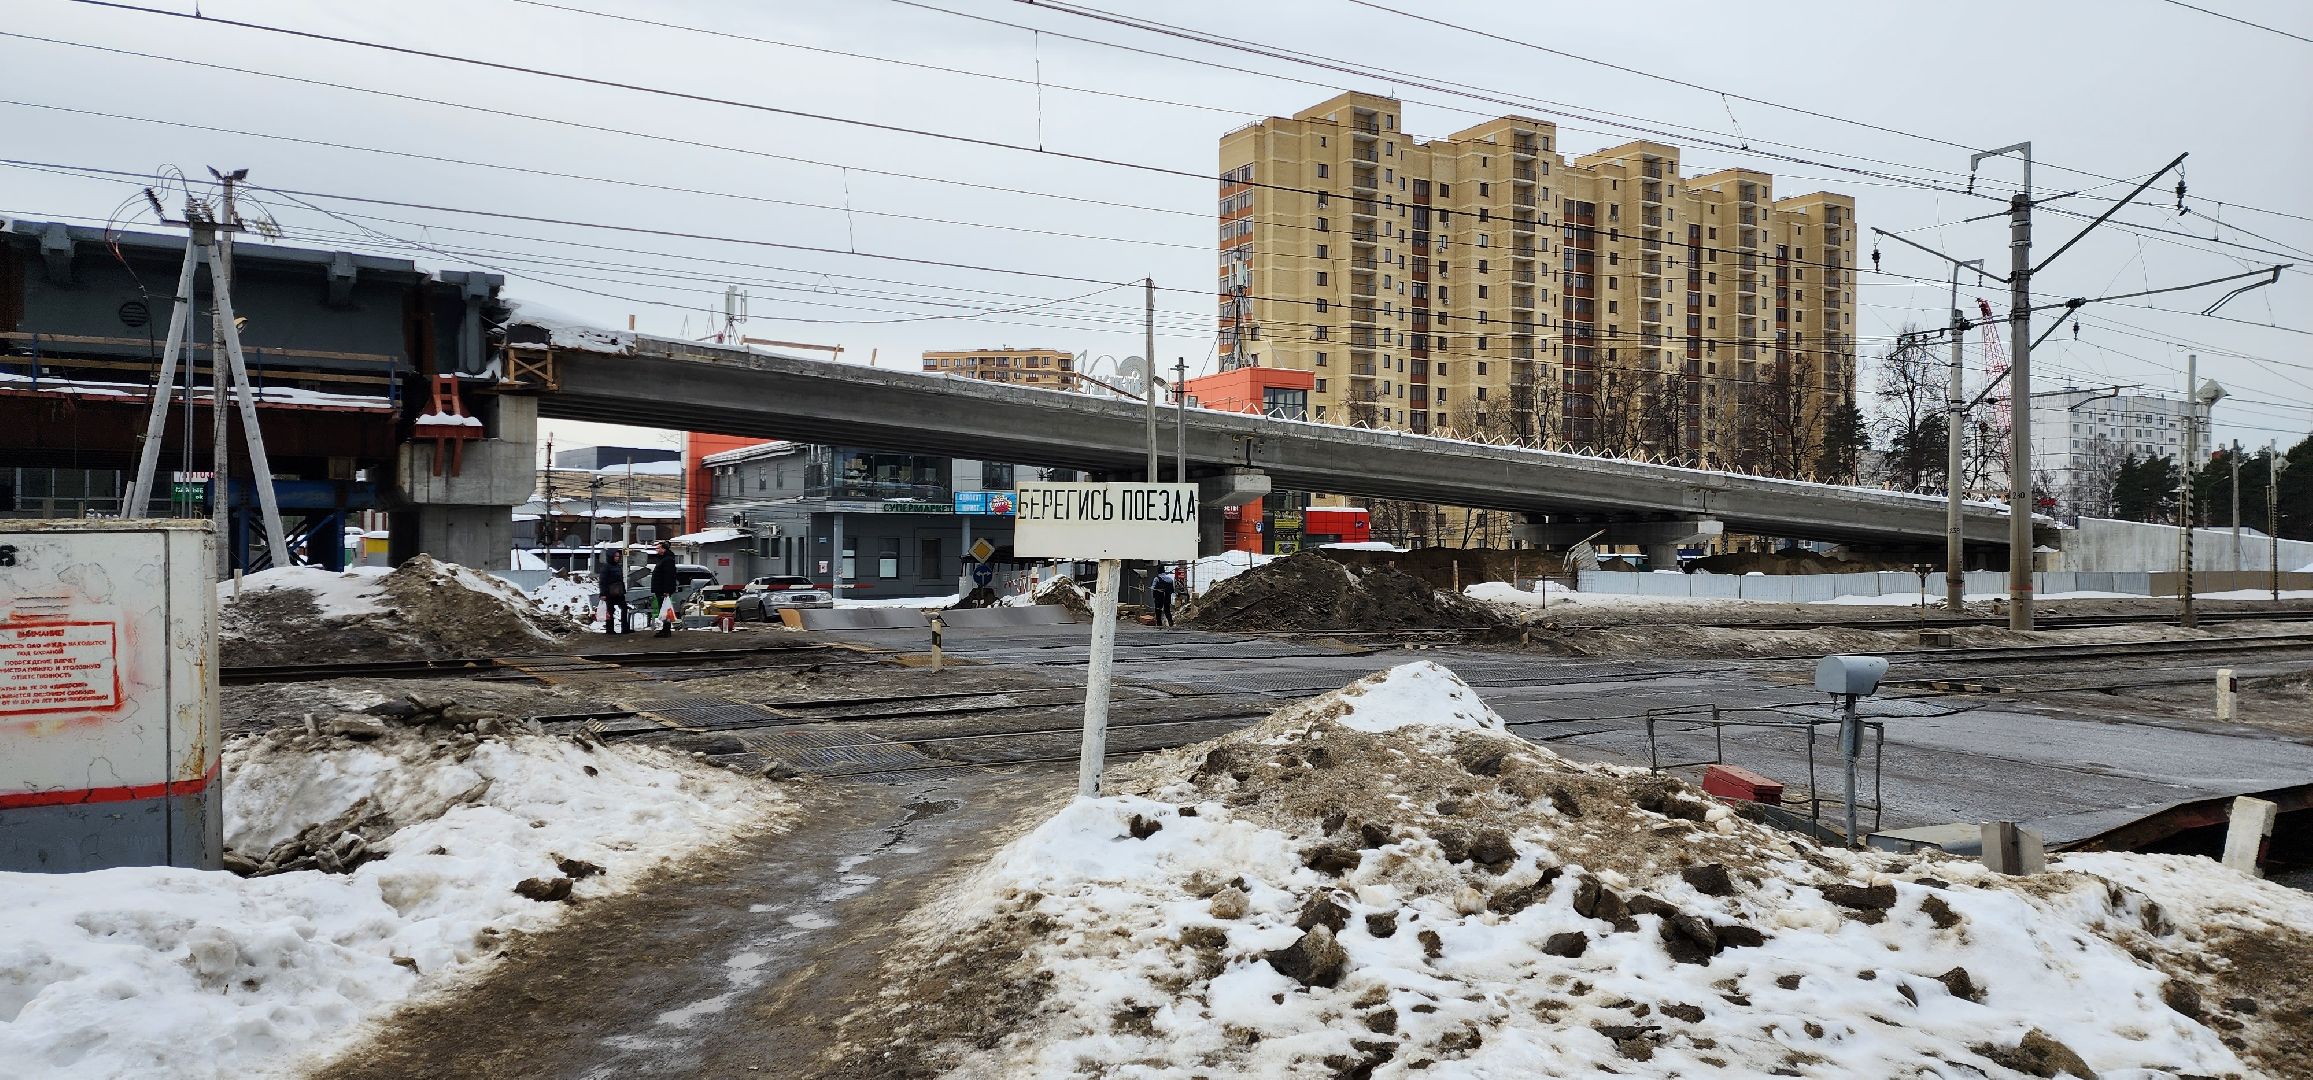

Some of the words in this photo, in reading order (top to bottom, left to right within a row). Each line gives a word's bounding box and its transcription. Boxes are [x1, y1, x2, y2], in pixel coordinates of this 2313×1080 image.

[883, 503, 953, 512] СУПЕРМАРКЕТ
[1018, 488, 1114, 520] БЕРЕГИСЬ
[1122, 489, 1196, 524] ПОЕЗДА
